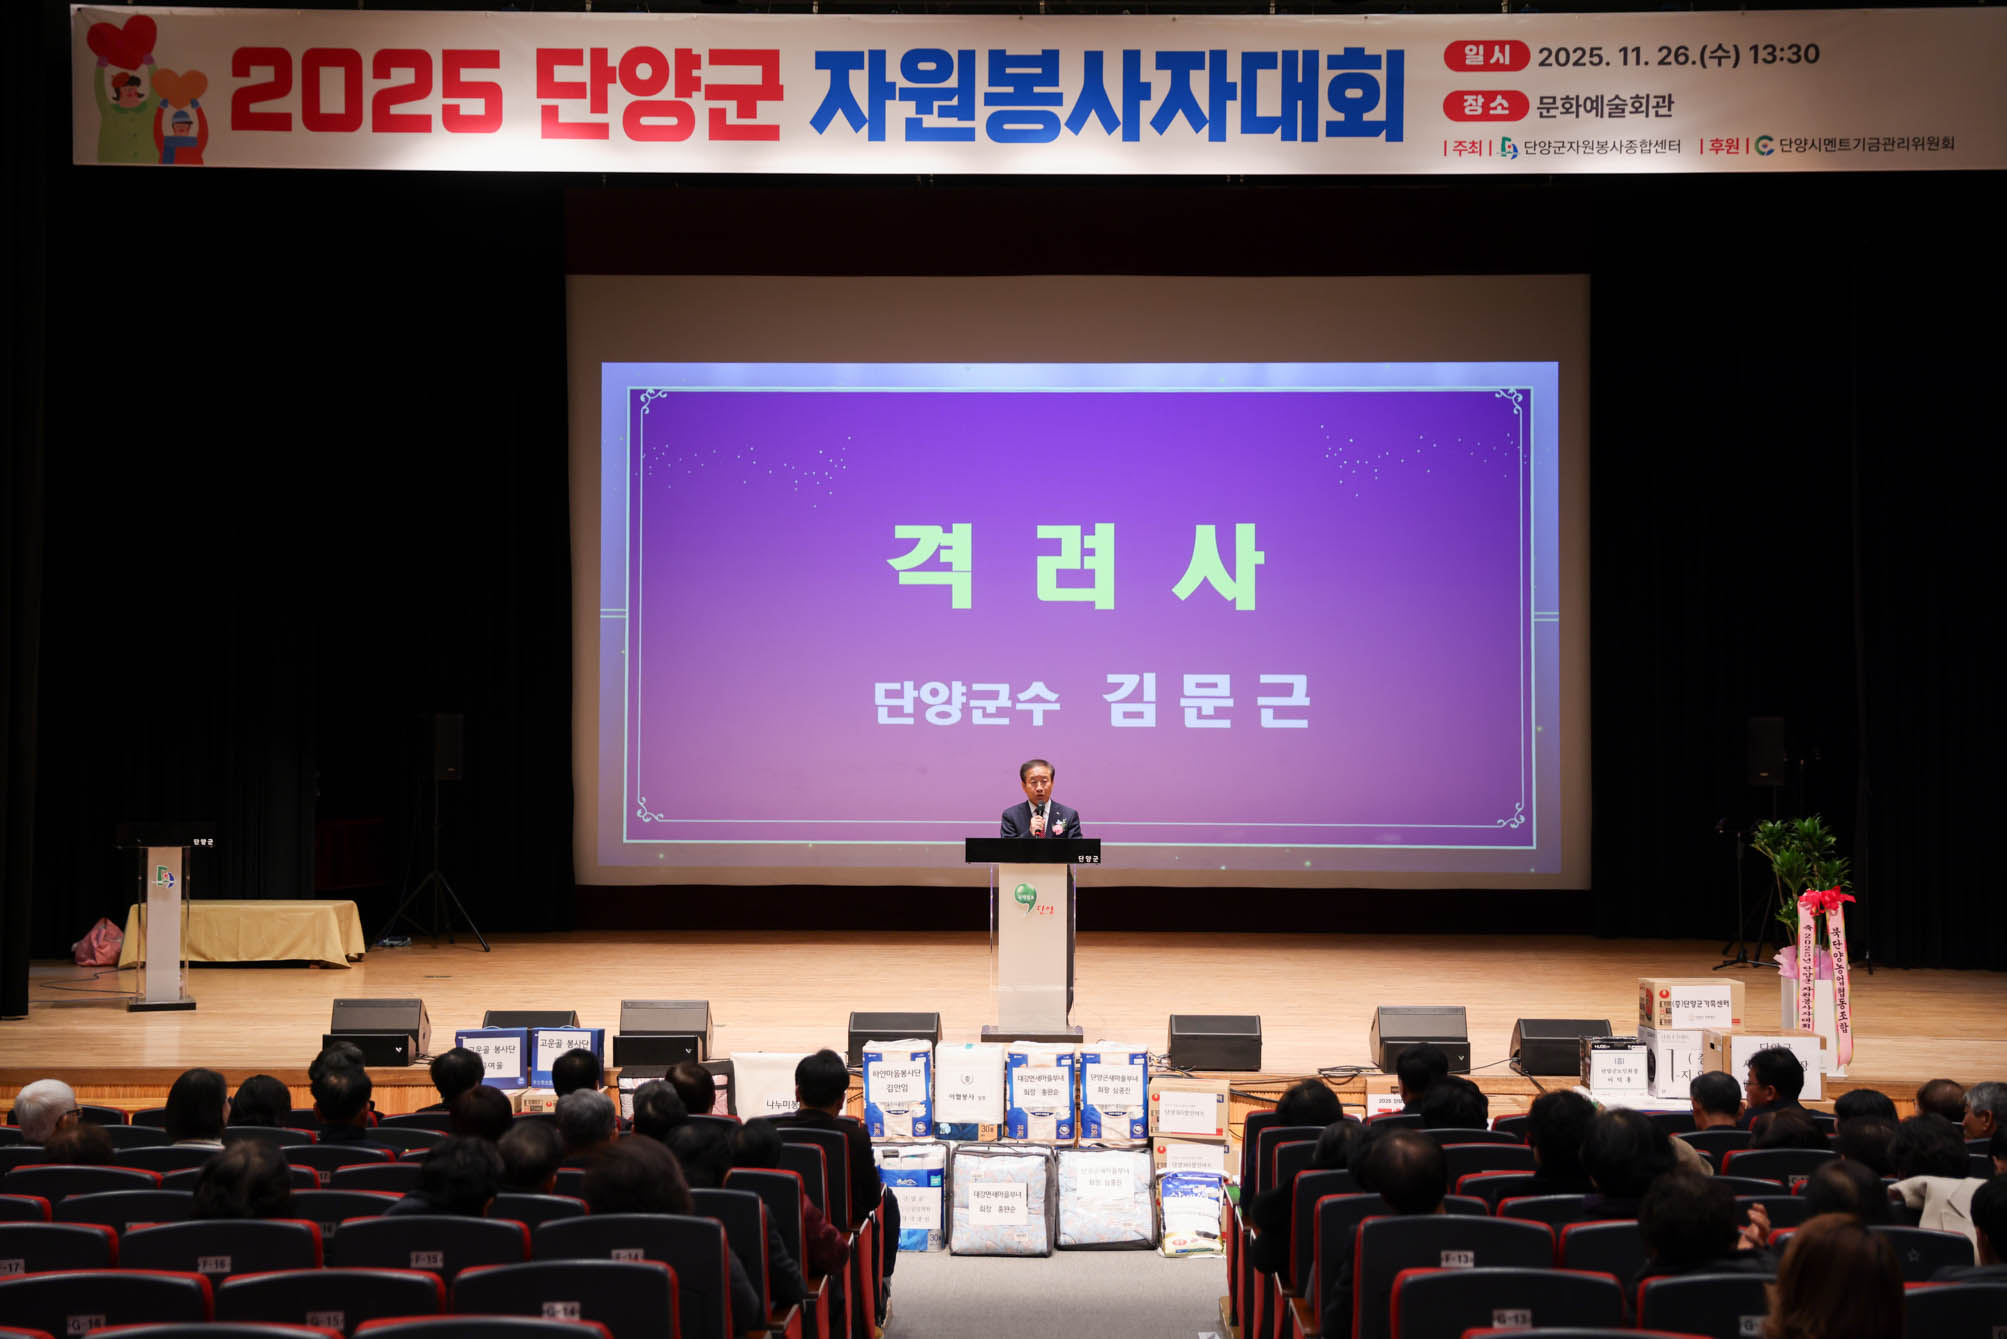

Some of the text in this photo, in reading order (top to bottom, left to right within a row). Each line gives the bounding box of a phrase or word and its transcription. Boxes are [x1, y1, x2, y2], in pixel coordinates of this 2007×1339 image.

[1538, 46, 1611, 67] 2025.
[1618, 46, 1649, 66] 11.
[1658, 43, 1741, 70] 26.(수)
[1749, 43, 1820, 65] 13:30
[231, 45, 1405, 143] 2025 단양군 자원봉사자대회
[1536, 93, 1674, 119] 문화예술회관
[1523, 139, 1682, 156] 단양군자원봉사종합센터
[1780, 136, 1956, 154] 단양시멘트기금관리위원회
[874, 681, 1061, 726] 단양군수
